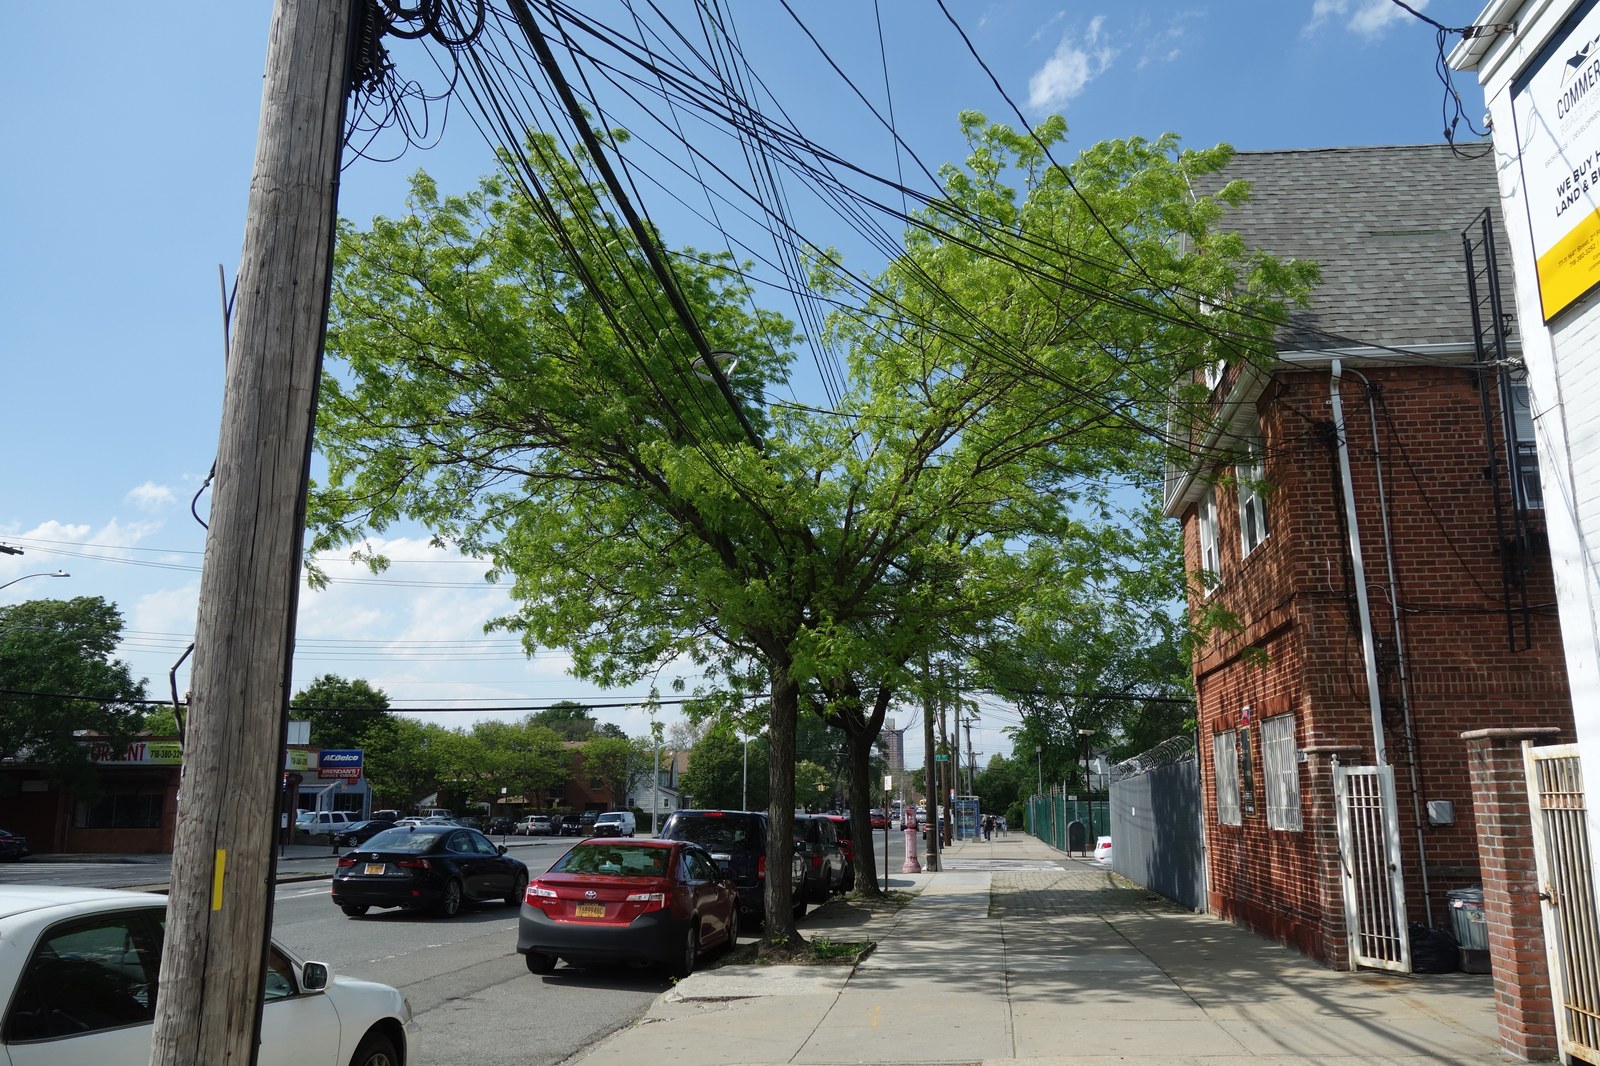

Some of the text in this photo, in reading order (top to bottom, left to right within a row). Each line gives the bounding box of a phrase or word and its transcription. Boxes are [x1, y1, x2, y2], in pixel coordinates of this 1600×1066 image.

[1557, 176, 1571, 198] WE
[1573, 154, 1592, 183] BUY
[1556, 187, 1580, 217] LAND
[1582, 179, 1589, 193] &
